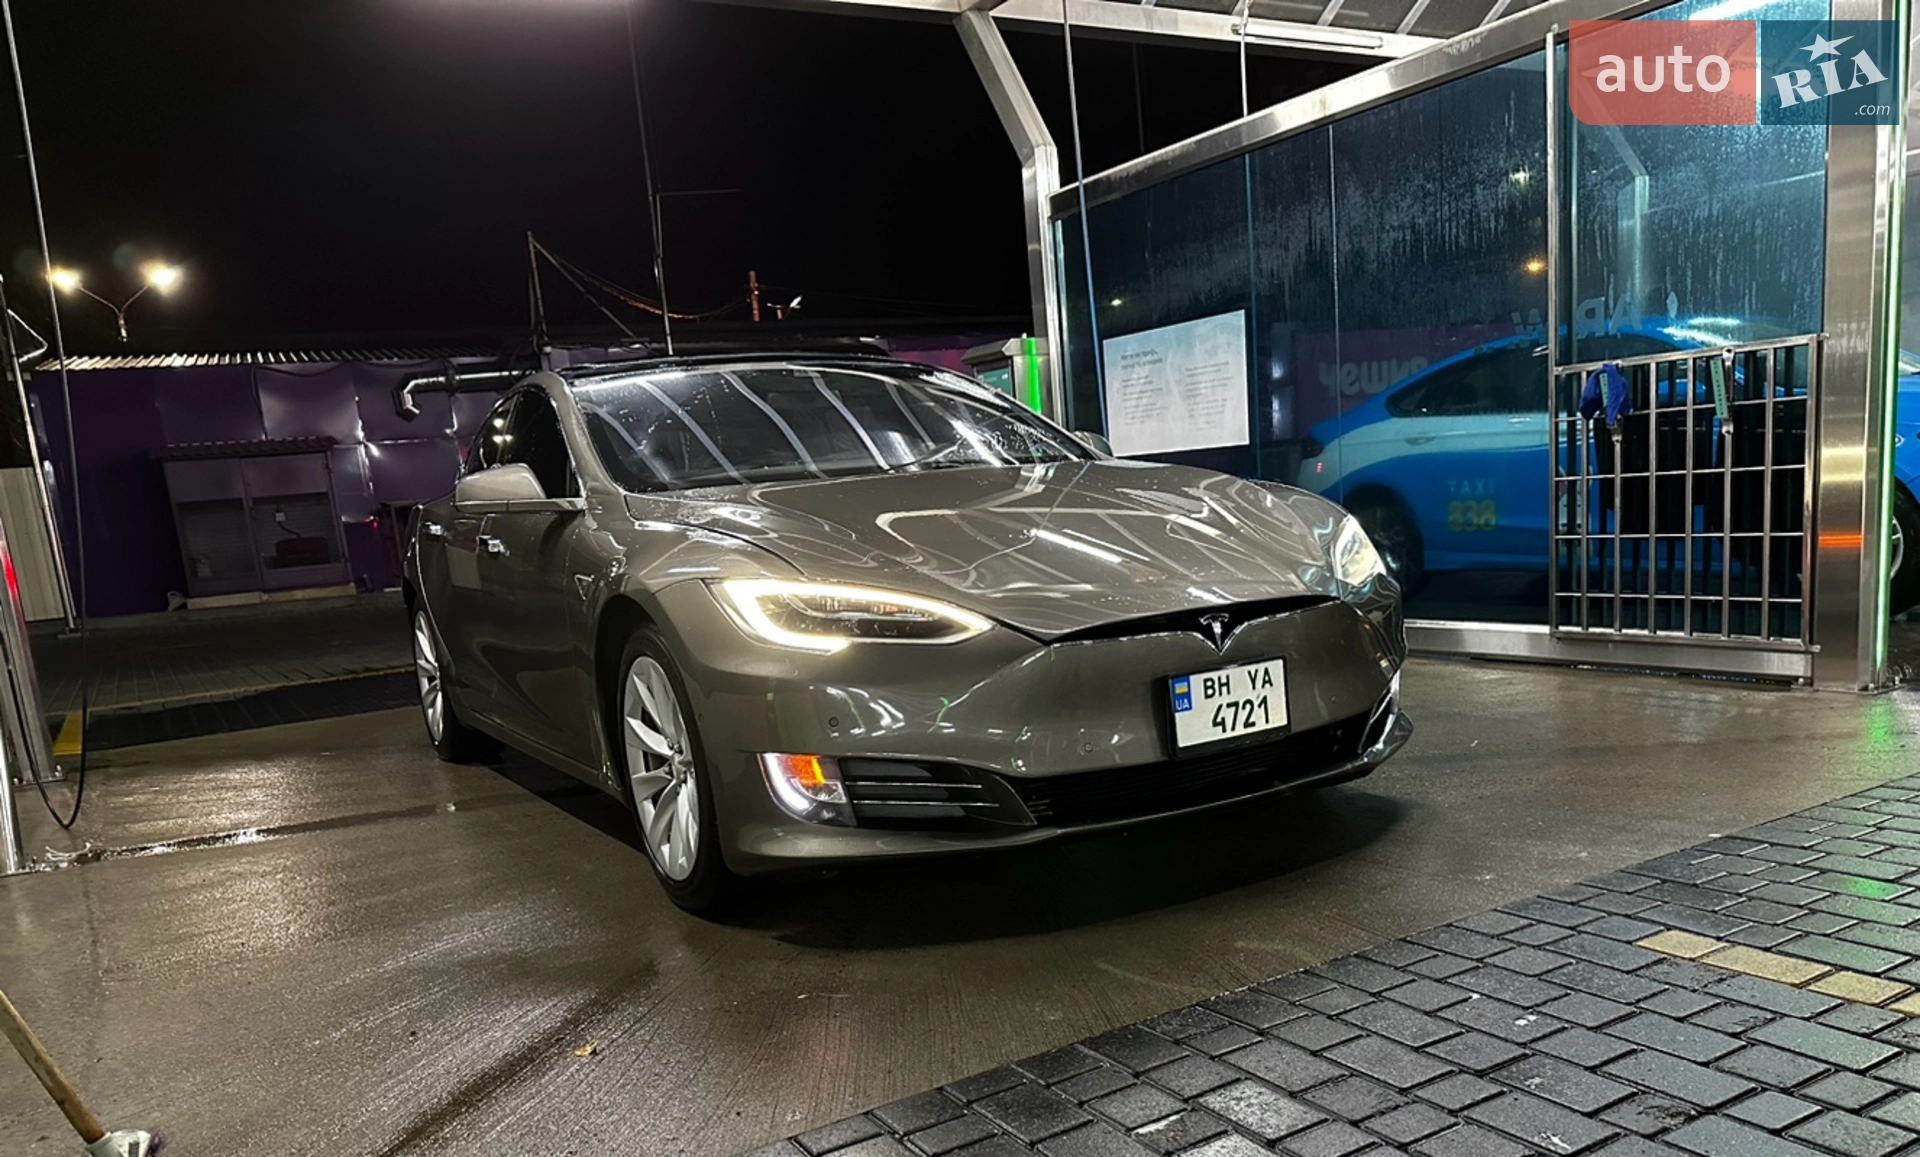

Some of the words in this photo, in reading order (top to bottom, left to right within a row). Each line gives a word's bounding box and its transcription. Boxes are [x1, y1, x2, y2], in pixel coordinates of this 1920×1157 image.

[1448, 478, 1494, 496] TAXI
[1203, 674, 1231, 699] BH
[1247, 667, 1273, 690] YA
[1175, 698, 1190, 710] UA
[1212, 695, 1269, 733] 4721
